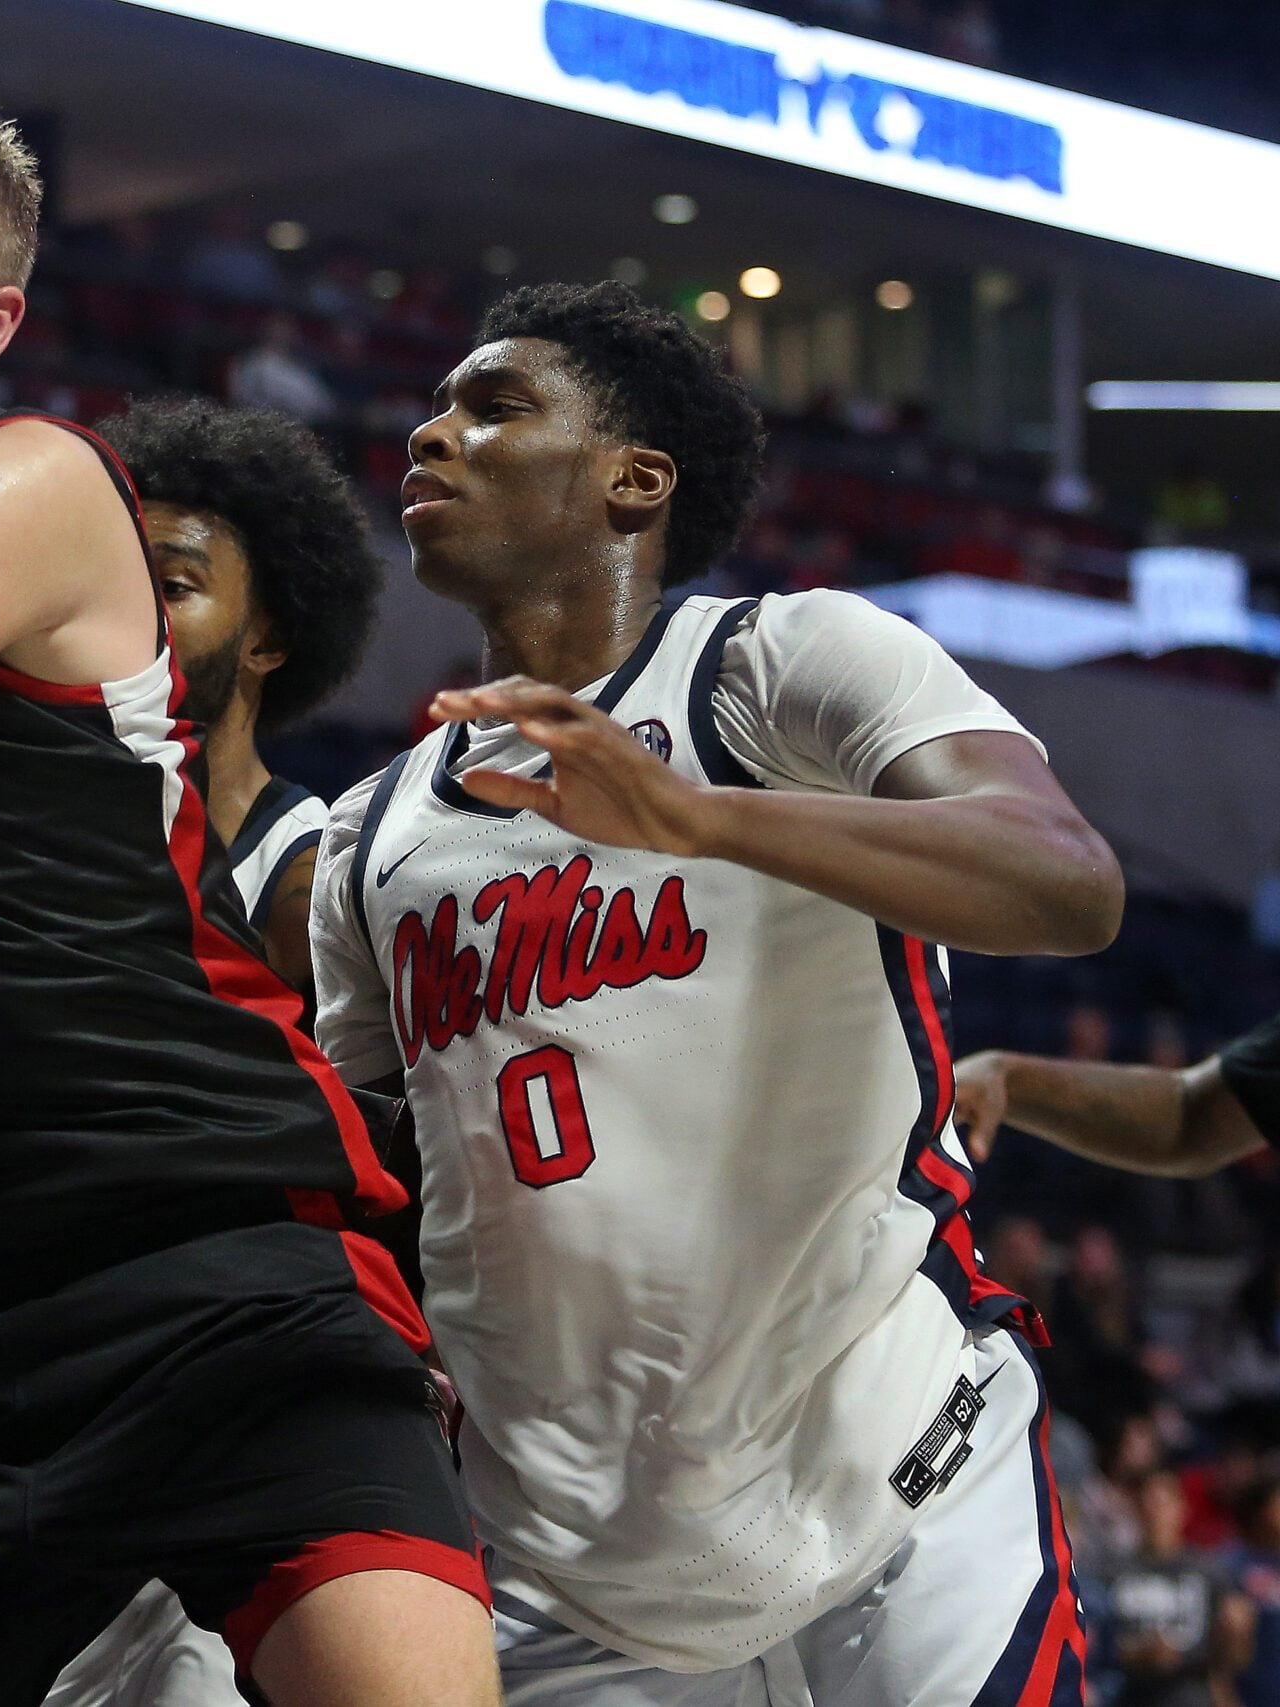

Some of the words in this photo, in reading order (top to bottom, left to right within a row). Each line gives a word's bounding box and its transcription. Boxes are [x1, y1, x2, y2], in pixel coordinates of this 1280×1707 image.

[393, 894, 483, 1069] Ole
[472, 853, 708, 1025] Miss
[496, 1043, 597, 1190] 0
[917, 1416, 947, 1455] ENGINEERED
[954, 1398, 972, 1422] 52
